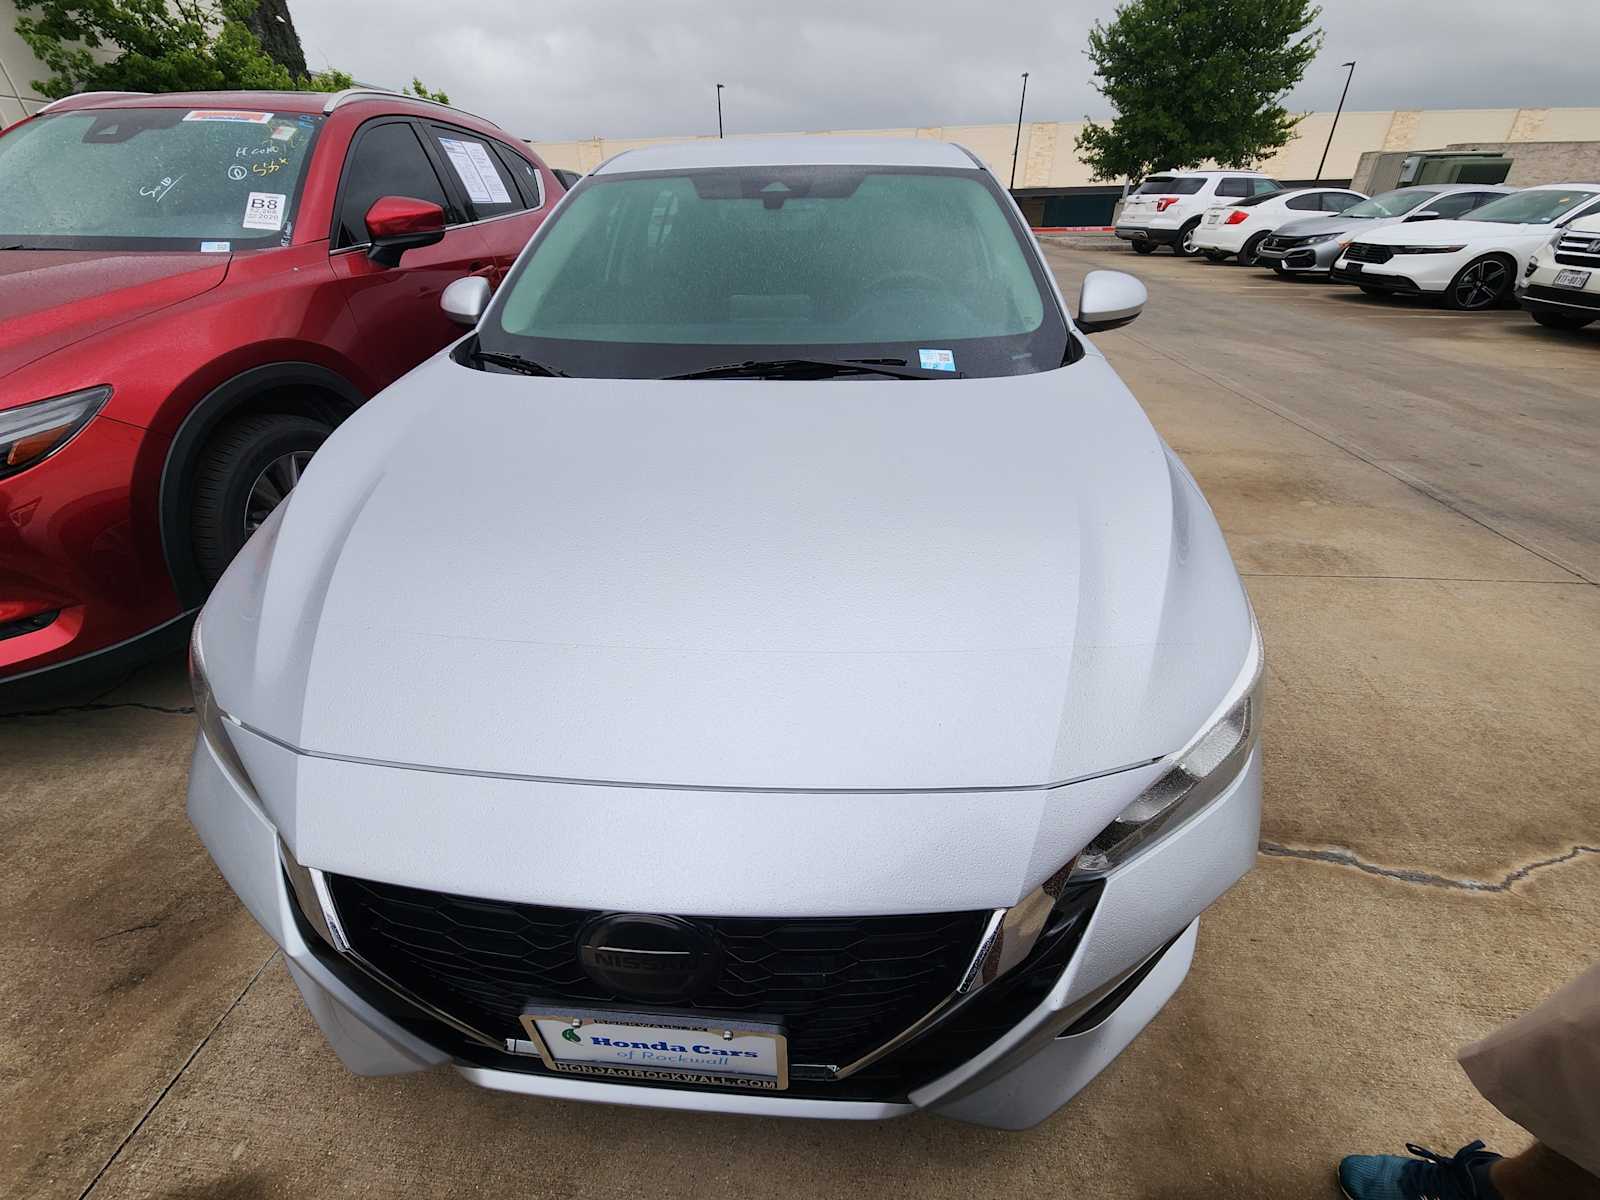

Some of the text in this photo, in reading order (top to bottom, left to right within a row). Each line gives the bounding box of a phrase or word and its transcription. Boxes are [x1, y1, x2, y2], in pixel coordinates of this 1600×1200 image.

[251, 198, 278, 210] B8
[590, 1036, 759, 1059] Honda Cars
[616, 1050, 730, 1066] of Rockwall
